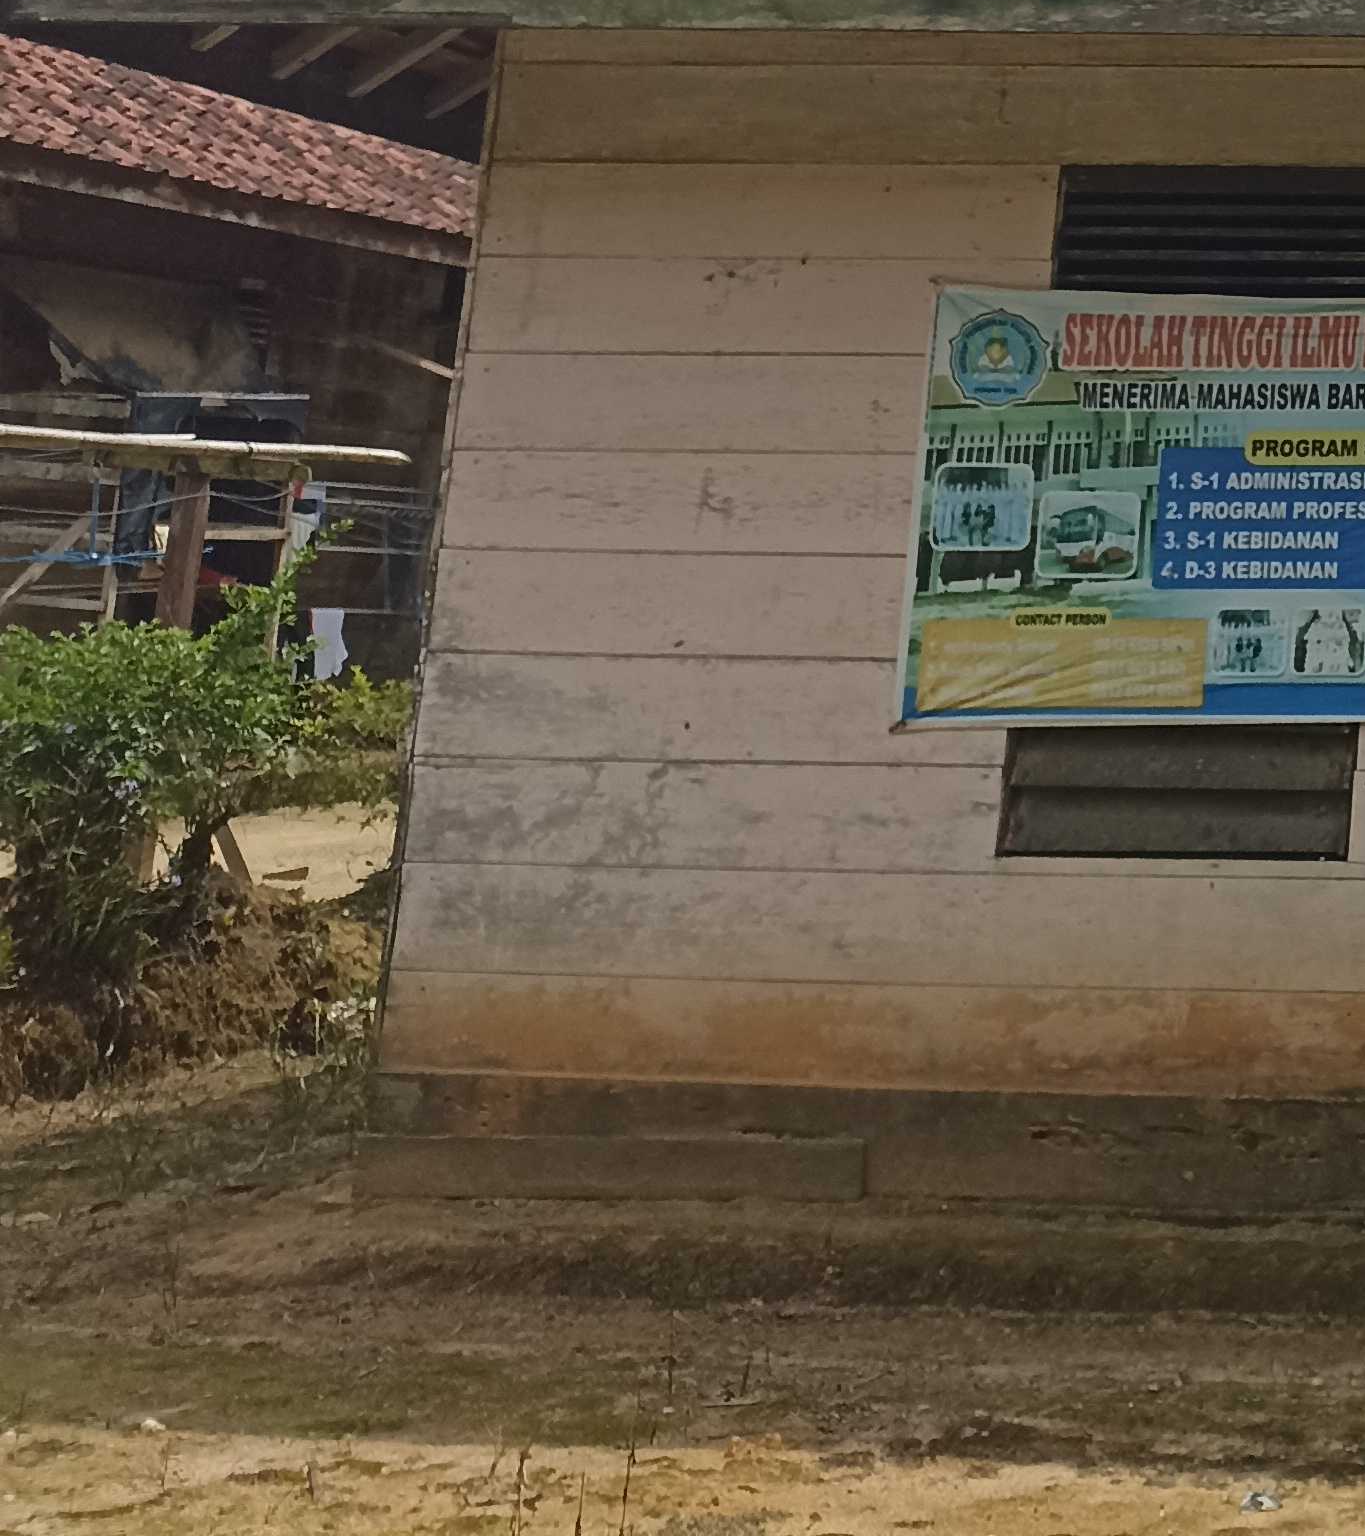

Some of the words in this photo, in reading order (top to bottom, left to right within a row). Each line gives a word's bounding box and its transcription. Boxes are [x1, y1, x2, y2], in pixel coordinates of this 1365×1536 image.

[1062, 314, 1187, 367] SEKOLAH
[1190, 315, 1286, 368] TINGGI
[1289, 315, 1360, 368] ILMU
[1082, 382, 1190, 409] MENERIMA
[1196, 383, 1320, 409] MAHASISWA
[1251, 439, 1357, 457] PROGRAM
[1168, 472, 1184, 490] 1.
[1190, 472, 1219, 490] S-1
[1165, 502, 1183, 520] 2.
[1189, 502, 1287, 519] PROGRAM
[1164, 532, 1181, 550] 3.
[1186, 532, 1216, 549] S-1
[1222, 532, 1339, 549] KEBIDANAN
[1160, 562, 1178, 580] 4.
[1185, 562, 1216, 579] D-3
[1222, 562, 1338, 579] KEBIDANAN
[1015, 614, 1063, 626] CONTACT
[1065, 614, 1107, 626] PERSON
